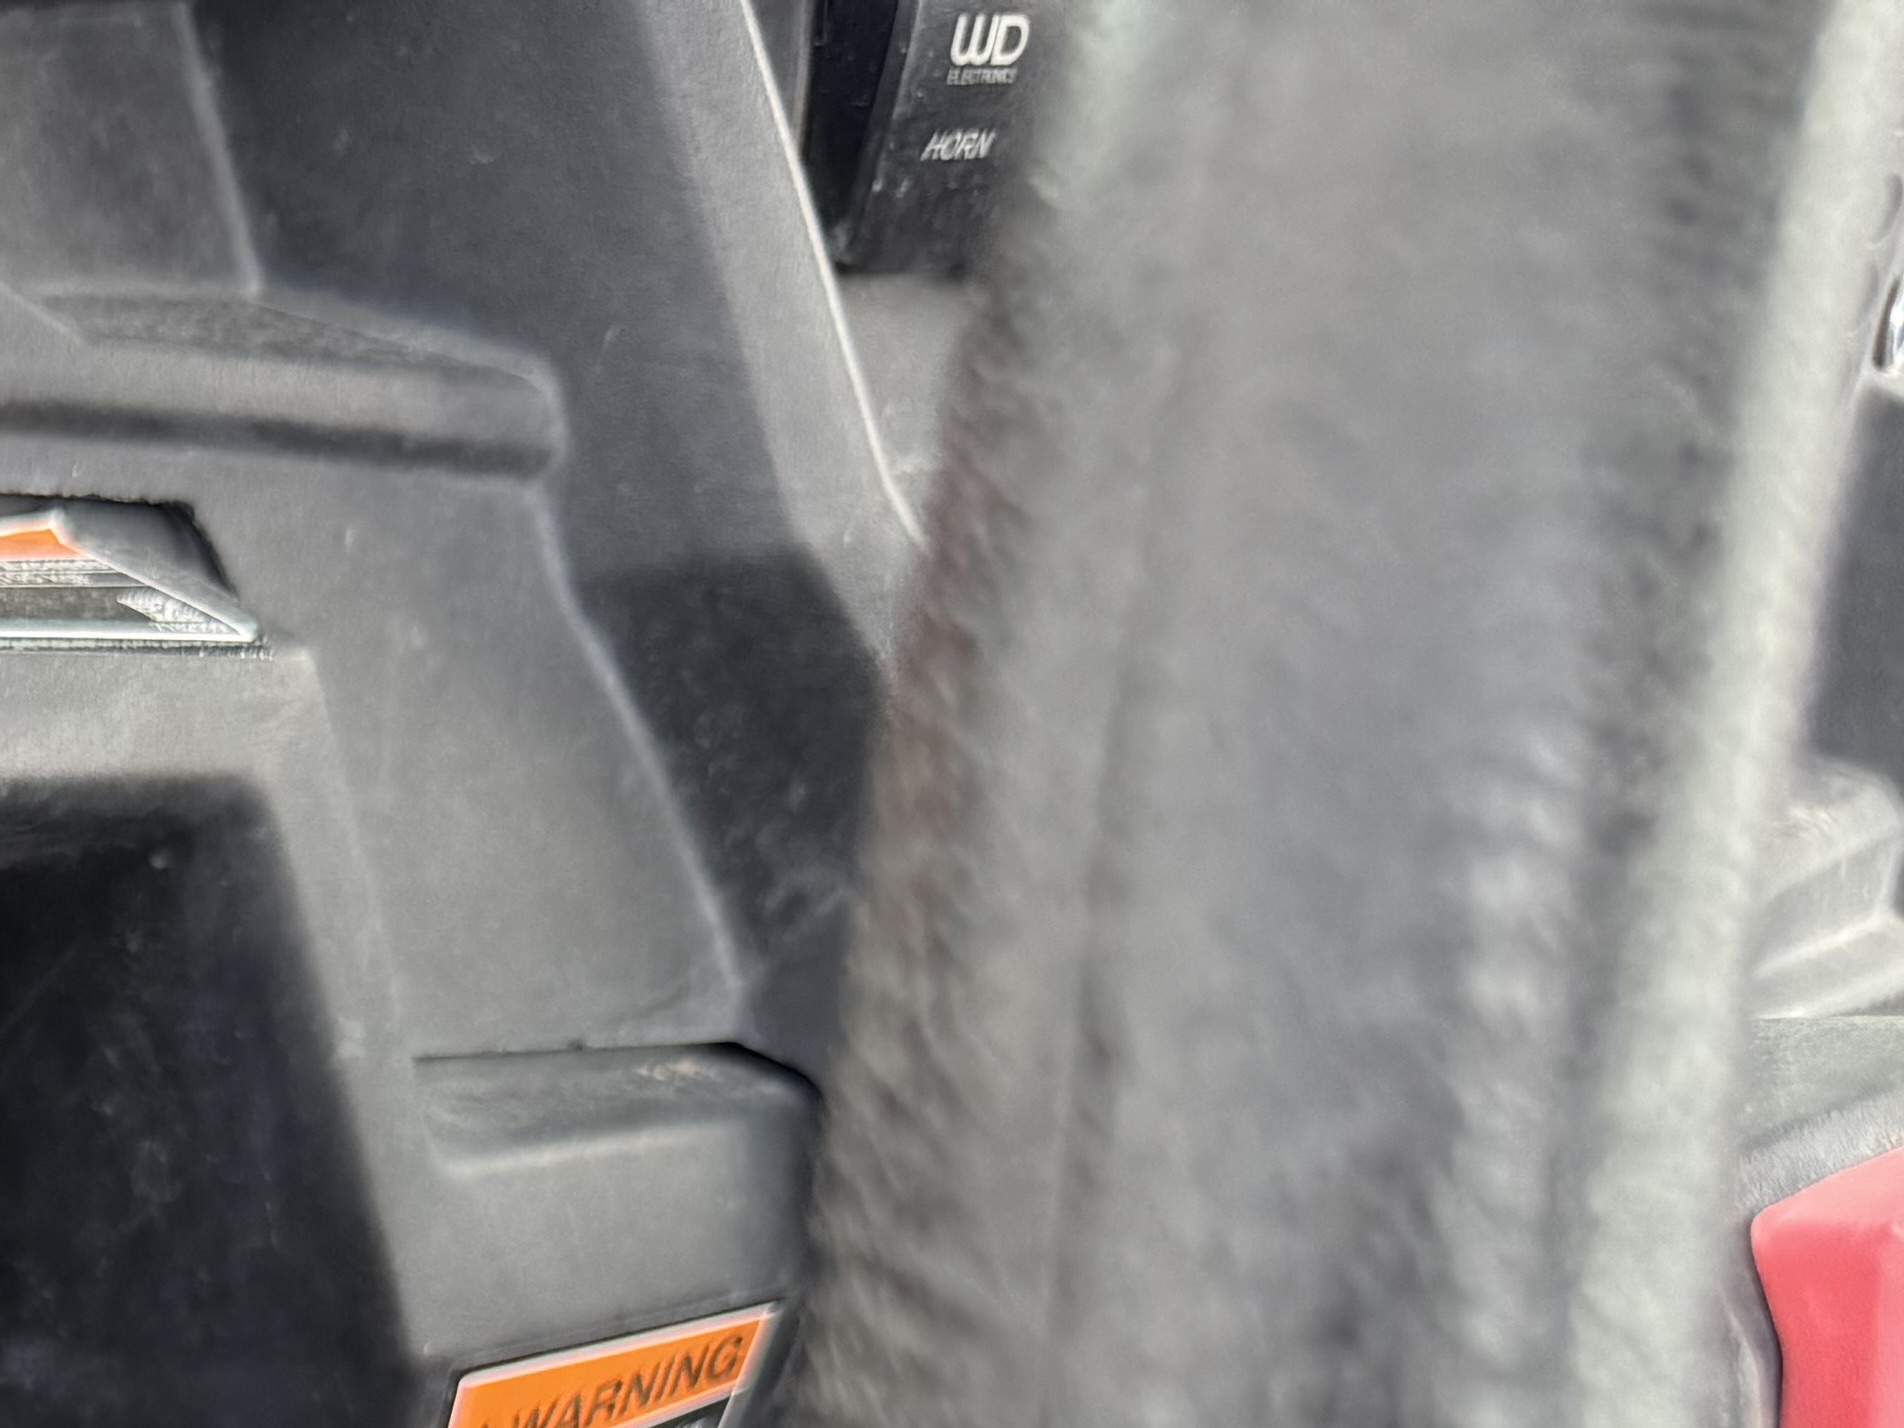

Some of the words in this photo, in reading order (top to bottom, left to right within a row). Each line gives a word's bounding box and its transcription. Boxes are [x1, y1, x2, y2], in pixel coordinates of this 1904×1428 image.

[950, 13, 1031, 66] WD
[946, 68, 1018, 85] ELECTRONICS
[920, 128, 996, 161] HORN
